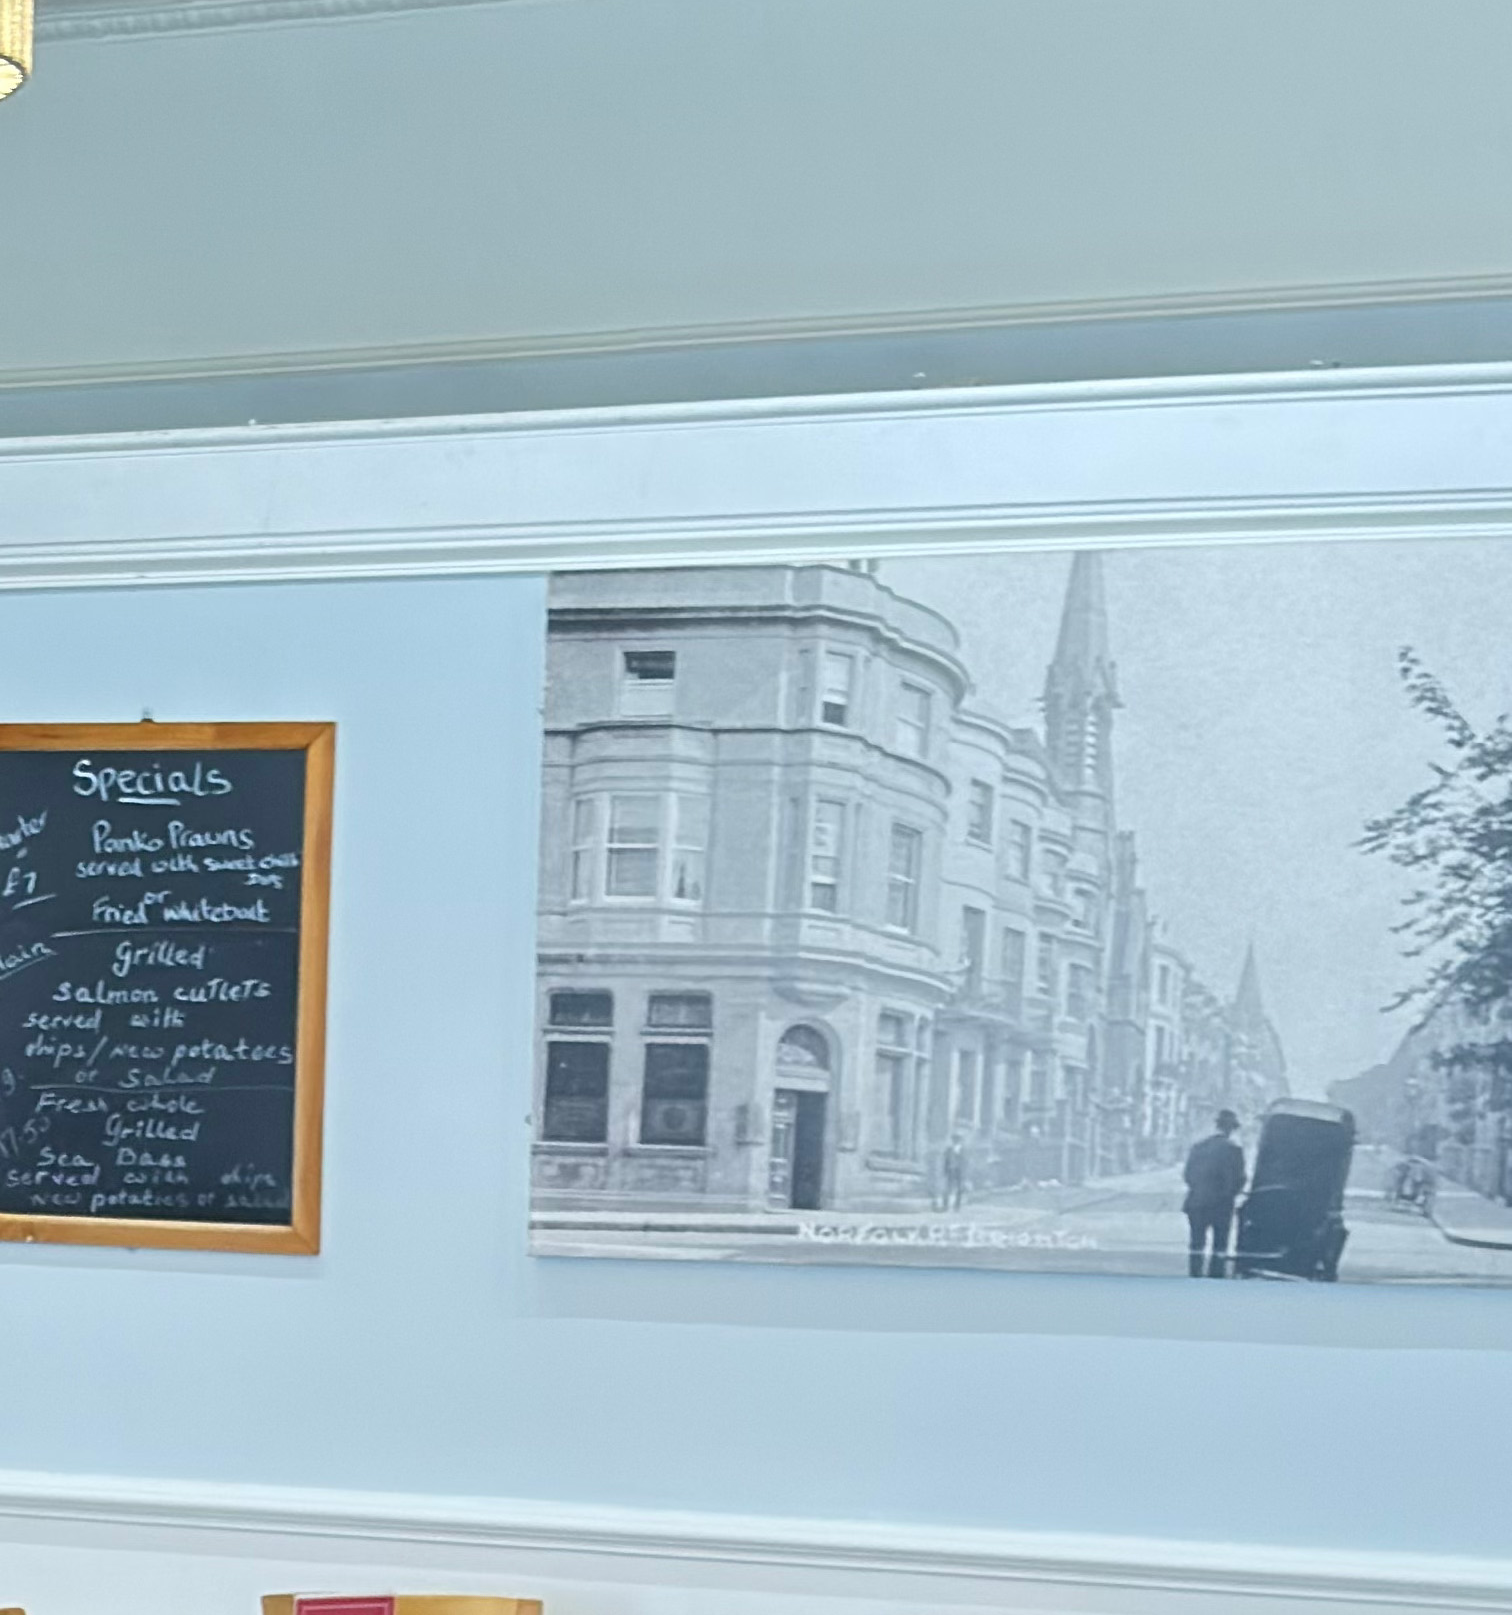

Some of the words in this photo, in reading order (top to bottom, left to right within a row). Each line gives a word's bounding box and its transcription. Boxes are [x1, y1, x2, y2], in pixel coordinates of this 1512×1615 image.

[73, 758, 233, 801] Specials
[168, 819, 256, 850] Prawns
[76, 855, 144, 879] served
[144, 890, 172, 905] or
